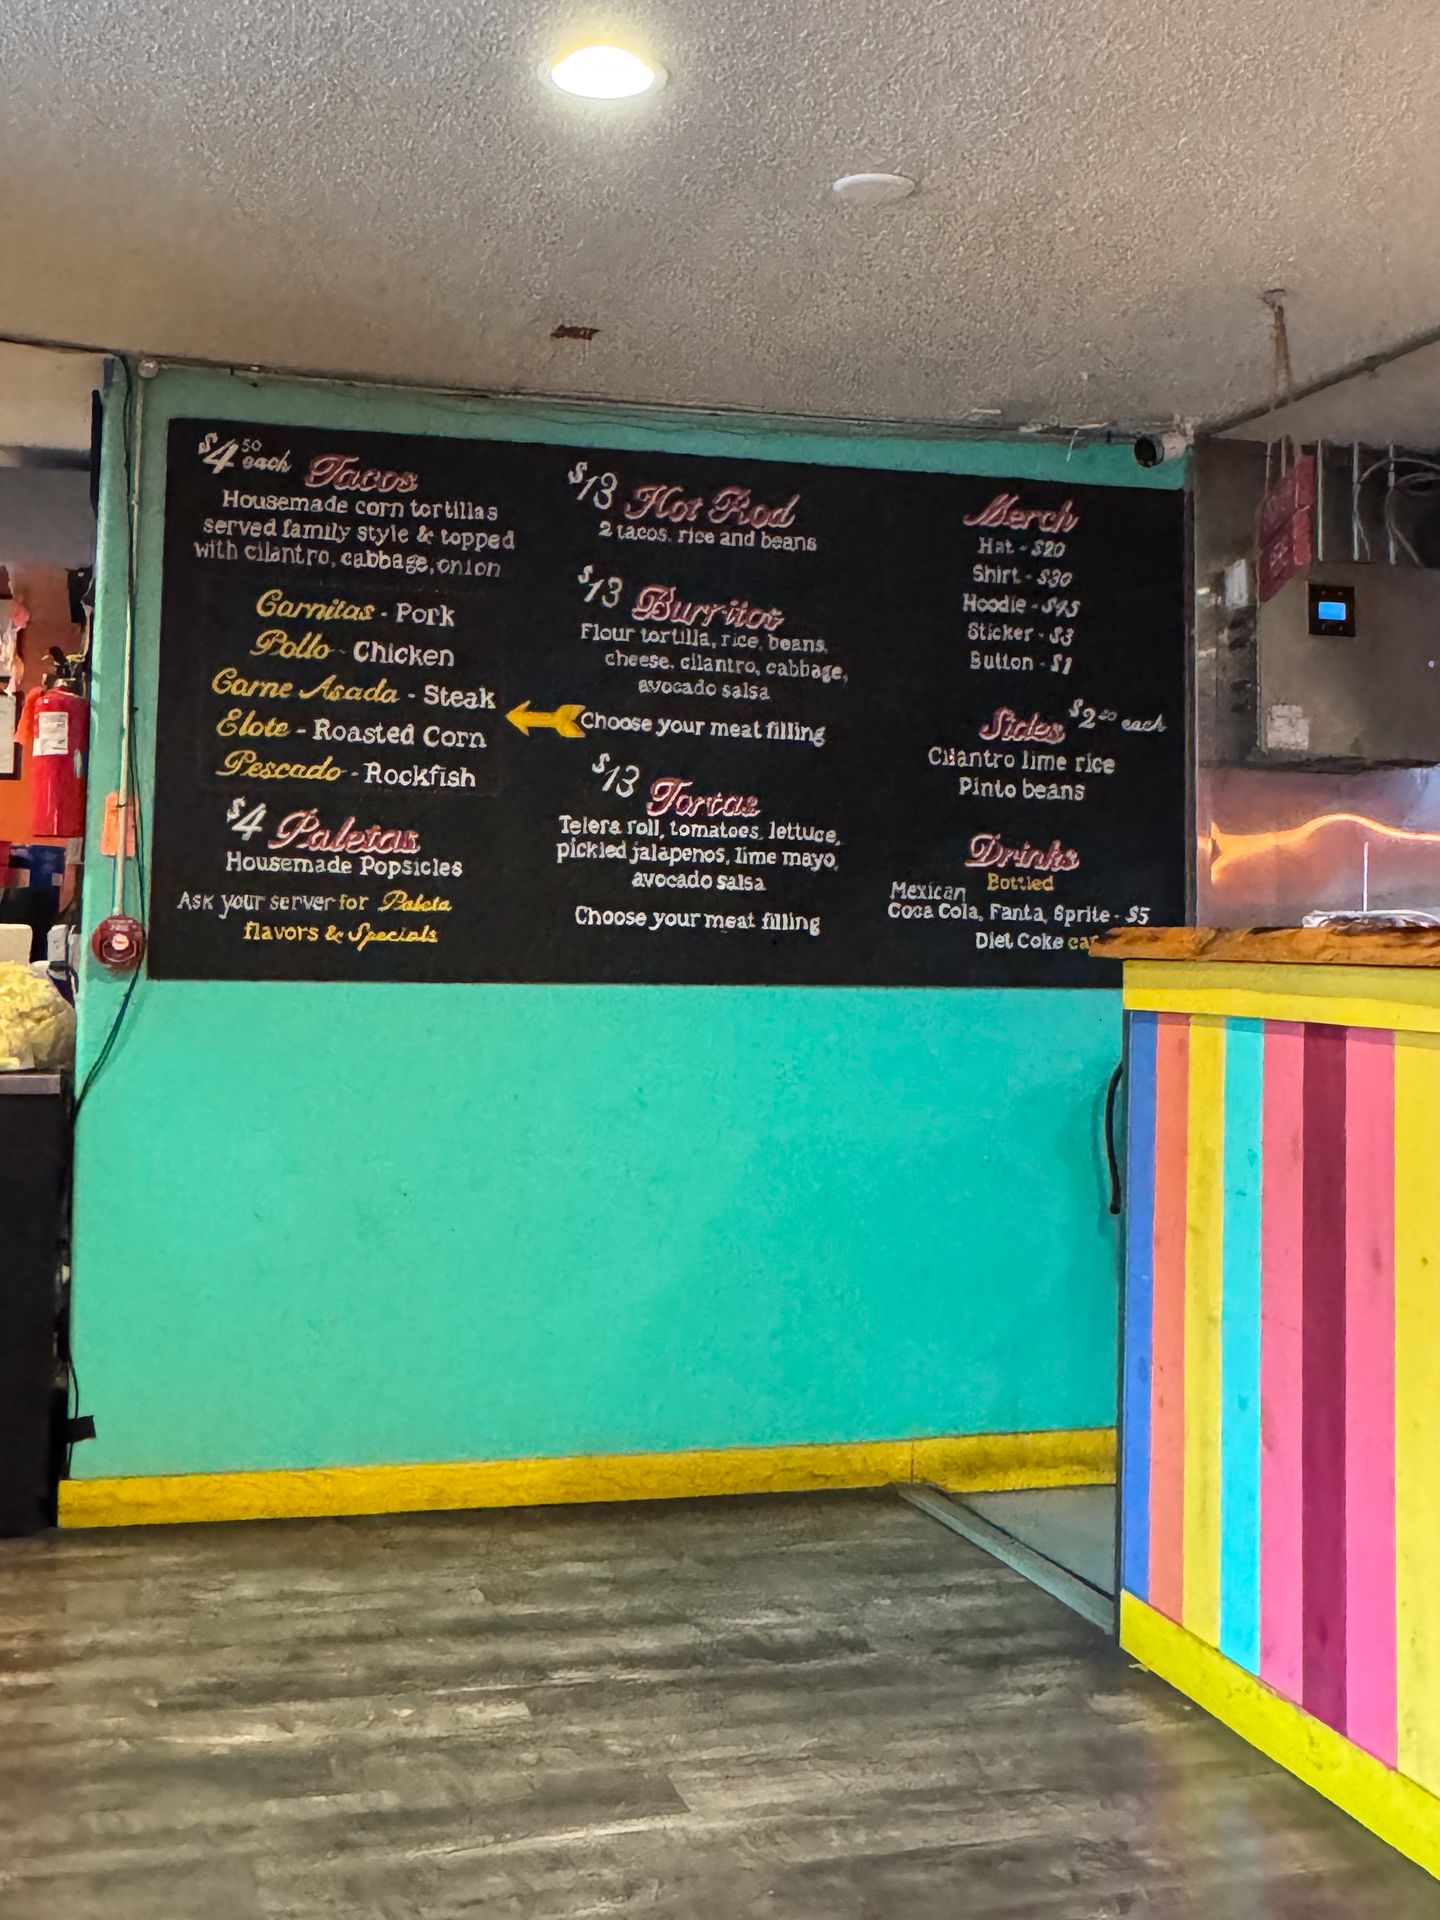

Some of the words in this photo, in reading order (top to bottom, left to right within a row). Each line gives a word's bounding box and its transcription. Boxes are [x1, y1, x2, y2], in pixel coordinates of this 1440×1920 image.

[242, 450, 292, 472] each
[305, 454, 418, 493] Tacos
[222, 490, 348, 515] Housemade
[355, 500, 403, 518] corn
[410, 500, 498, 521] tortillas
[568, 461, 618, 511] $13
[625, 485, 702, 522] Hot
[708, 486, 800, 529] Rod
[962, 493, 1080, 534] Merch
[203, 517, 277, 537] served
[283, 519, 350, 543] family
[358, 524, 409, 545] style
[416, 524, 434, 543] &
[441, 529, 515, 551] topped
[599, 521, 613, 537] 2
[678, 528, 715, 545] rice
[720, 531, 754, 547] and
[761, 532, 817, 551] beans
[978, 537, 1015, 555] Hat
[1030, 540, 1067, 559] $20
[194, 540, 238, 559] with
[244, 544, 336, 568] cilantro,
[341, 550, 435, 575] cabbage,
[437, 558, 500, 577] onion
[578, 564, 622, 608] $13
[973, 564, 1022, 584] Shirt
[1036, 569, 1073, 588] $30
[256, 589, 376, 620] Carnitas
[396, 602, 455, 627] Pork
[962, 593, 1027, 614] Hoodie
[250, 628, 334, 660] Pollo
[354, 641, 454, 667] Chicken
[580, 623, 636, 641] Flour
[640, 626, 716, 649] tortilla,
[769, 634, 828, 653] beans,
[967, 621, 1034, 642] Sticker
[1049, 626, 1075, 647] $3
[680, 655, 760, 676] cilantro,
[766, 660, 848, 684] cabbage,
[970, 650, 1034, 671] Button
[1050, 653, 1073, 675] $1
[212, 668, 293, 698] Carne
[299, 674, 400, 703] Asada
[423, 685, 496, 709] Steak
[638, 678, 717, 697] avocado
[722, 682, 770, 700] salsa
[216, 708, 290, 737] Elote
[312, 718, 415, 745] Roasted
[423, 726, 487, 749] Corn
[581, 711, 652, 732] Choose
[656, 717, 705, 736] your
[710, 720, 762, 739] meat
[766, 721, 826, 747] filling
[979, 705, 1067, 746] Sides
[1121, 713, 1168, 733] each
[215, 750, 347, 782] Pescado
[363, 761, 476, 788] Rockfish
[928, 746, 1015, 769] Cilantro
[1022, 750, 1067, 772] lime
[1075, 753, 1116, 775] rice
[591, 753, 640, 798] $13
[646, 777, 761, 818] Tortas
[958, 776, 1017, 799] Pinto
[1022, 779, 1085, 802] beans
[226, 796, 266, 841] $4
[268, 807, 420, 854] Paletas
[558, 815, 622, 835] Telera
[627, 817, 665, 840] roll,
[770, 821, 841, 846] lettuce,
[226, 851, 352, 874] Housemade
[360, 855, 463, 879] Popsicles
[557, 838, 626, 863] pickled
[735, 846, 777, 865] lime
[782, 851, 839, 871] mayo,
[964, 832, 1081, 873] Drinks
[632, 871, 712, 889] avocado
[716, 873, 766, 891] salsa
[889, 881, 967, 901] Mexican
[987, 872, 1054, 891] Bottled
[177, 891, 213, 910] Ask
[219, 894, 263, 919] your
[270, 895, 338, 911] server
[339, 893, 369, 911] for
[378, 889, 452, 913] Paleta
[887, 902, 934, 921] Coca
[938, 902, 984, 922] Cola,
[990, 904, 1048, 926] Fanta,
[1053, 904, 1110, 928] Sprite
[1125, 905, 1151, 925] $5
[575, 905, 647, 927] Choose
[649, 910, 700, 931] your
[704, 912, 756, 930] meat
[761, 913, 821, 936] filling
[244, 921, 318, 941] flavors
[325, 927, 342, 943] &
[348, 921, 438, 951] Specials
[975, 931, 1013, 950] Diet
[1017, 931, 1064, 950] Coke
